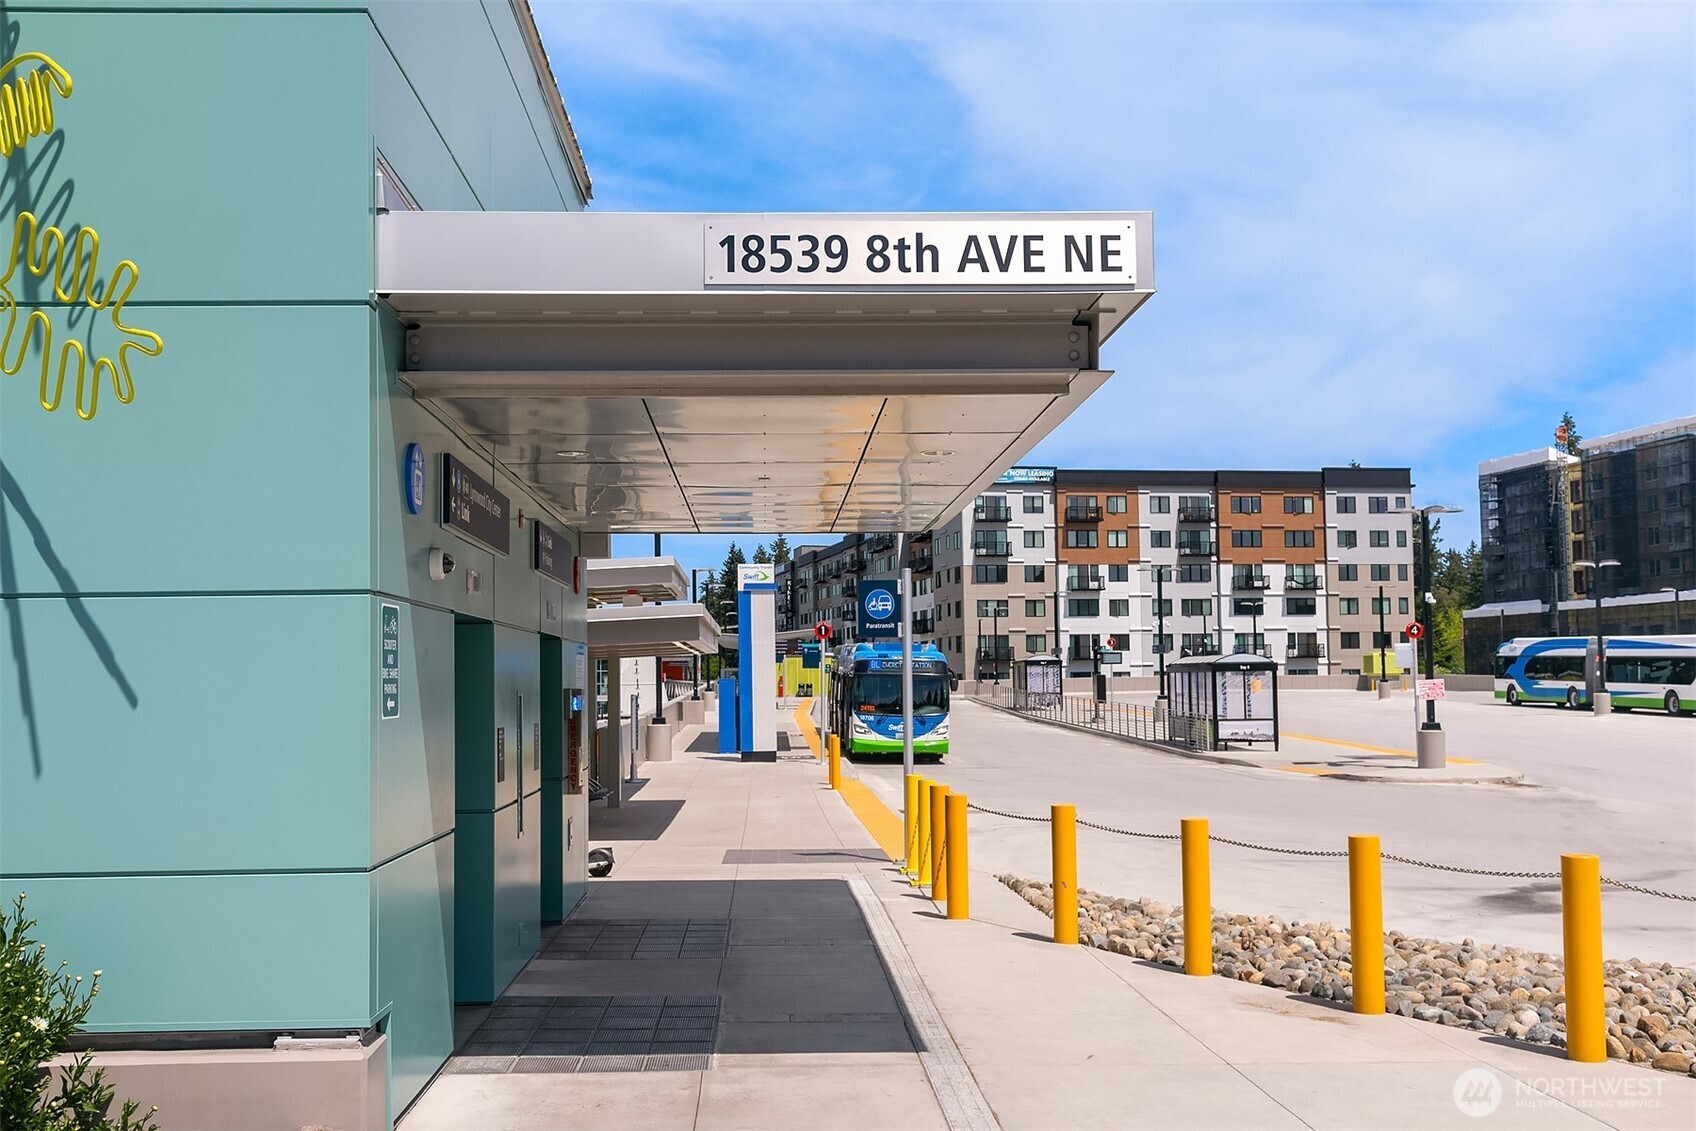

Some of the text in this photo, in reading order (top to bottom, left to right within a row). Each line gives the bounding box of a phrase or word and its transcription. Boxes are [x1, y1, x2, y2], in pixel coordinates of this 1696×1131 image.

[718, 232, 1123, 273] 18539 8th AVE NE
[820, 625, 825, 636] 1
[1410, 625, 1419, 635] 4
[871, 660, 880, 669] BL
